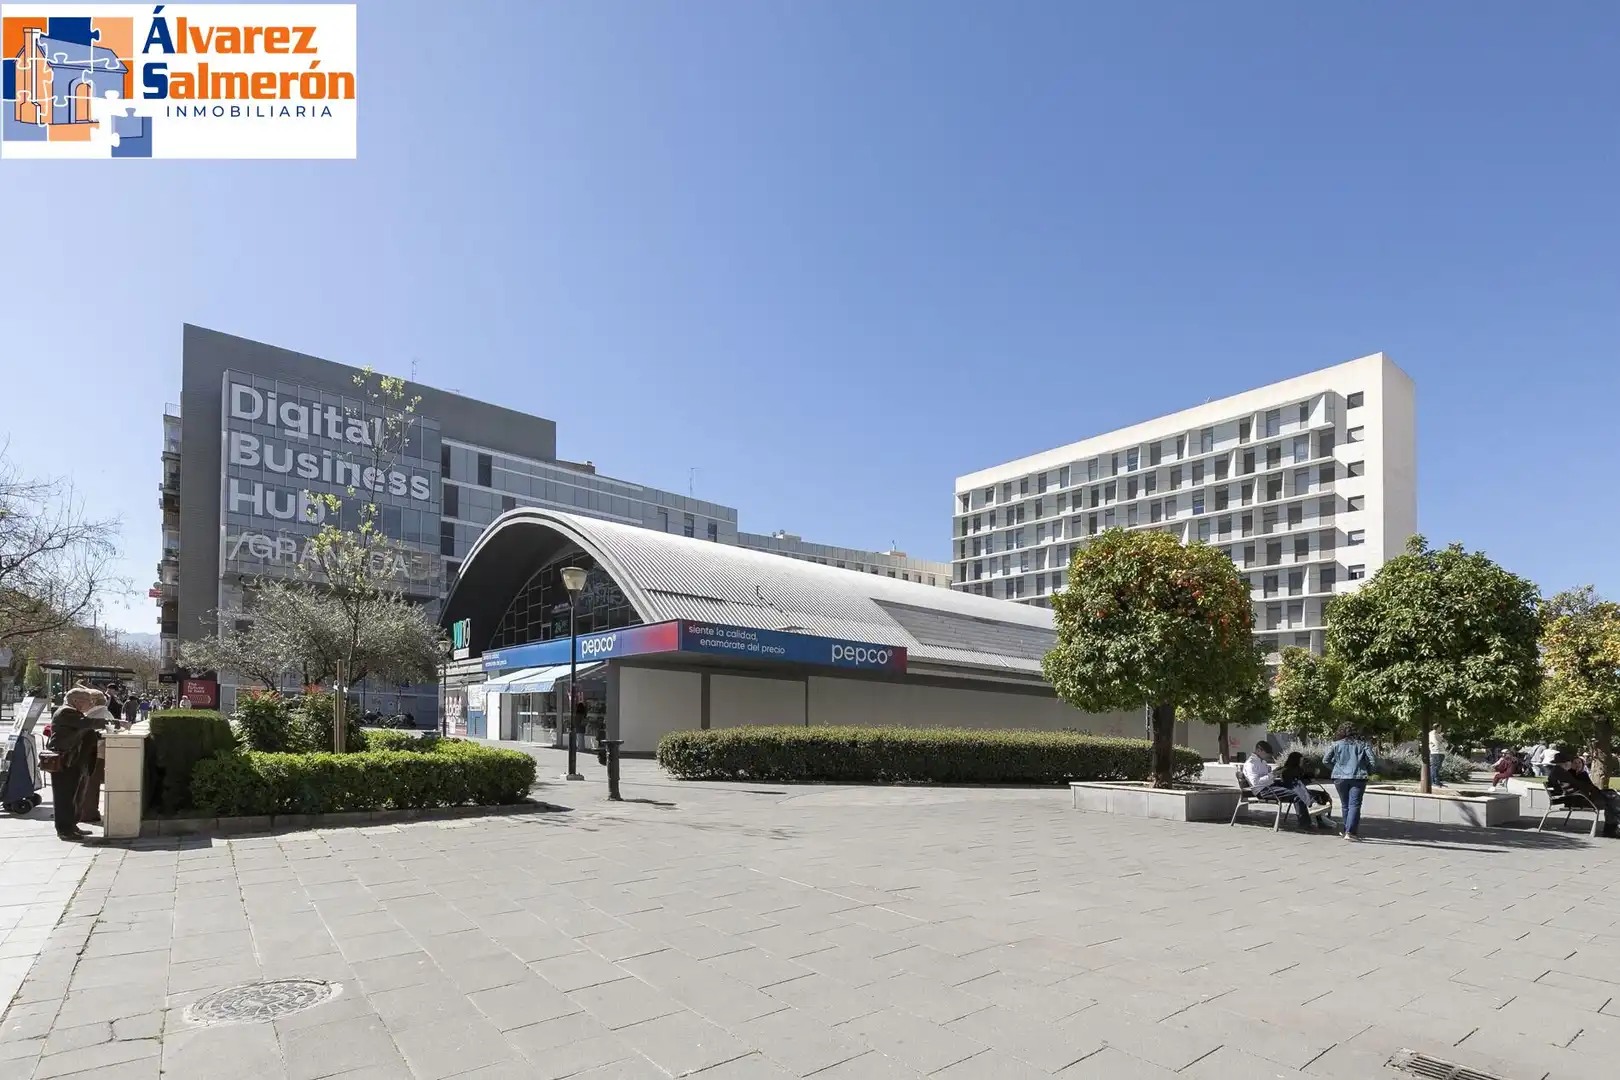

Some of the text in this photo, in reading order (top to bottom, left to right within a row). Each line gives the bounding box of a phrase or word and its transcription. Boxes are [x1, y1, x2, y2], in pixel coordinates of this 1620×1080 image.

[230, 383, 383, 446] Digital
[230, 431, 430, 500] Business
[689, 625, 759, 642] siente la calidad,
[700, 638, 786, 656] enamórate del precio
